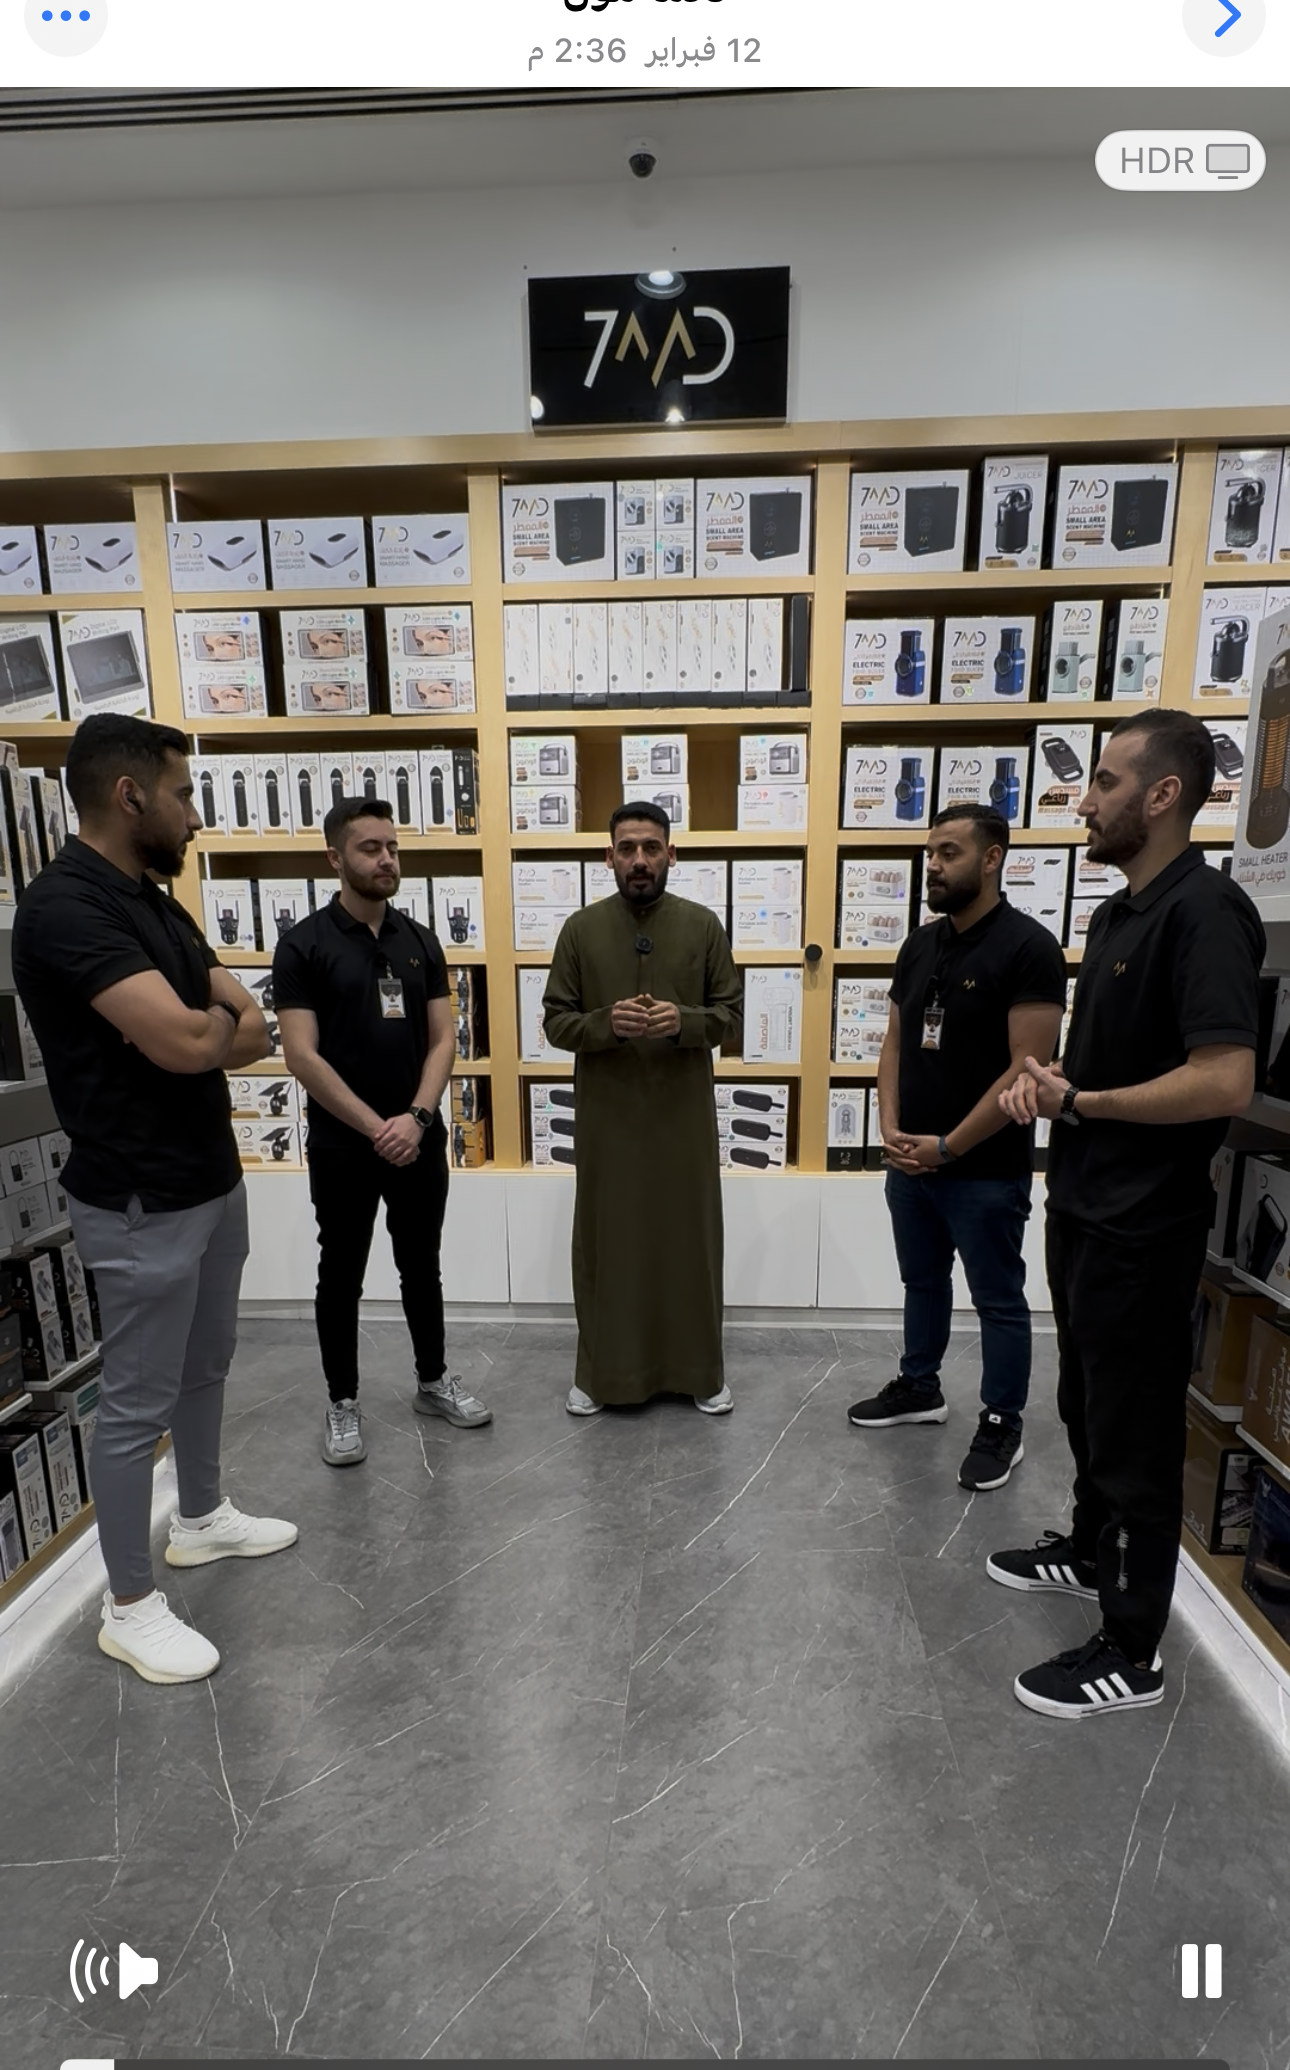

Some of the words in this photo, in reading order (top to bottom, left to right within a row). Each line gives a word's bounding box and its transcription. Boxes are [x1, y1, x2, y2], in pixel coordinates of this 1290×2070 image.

[1065, 517, 1088, 525] SMALL
[1090, 515, 1106, 523] AREA
[852, 661, 885, 669] ELECTRIC
[951, 659, 985, 667] ELECTRIC
[1238, 856, 1260, 868] SMALL
[1261, 851, 1289, 866] HEATER
